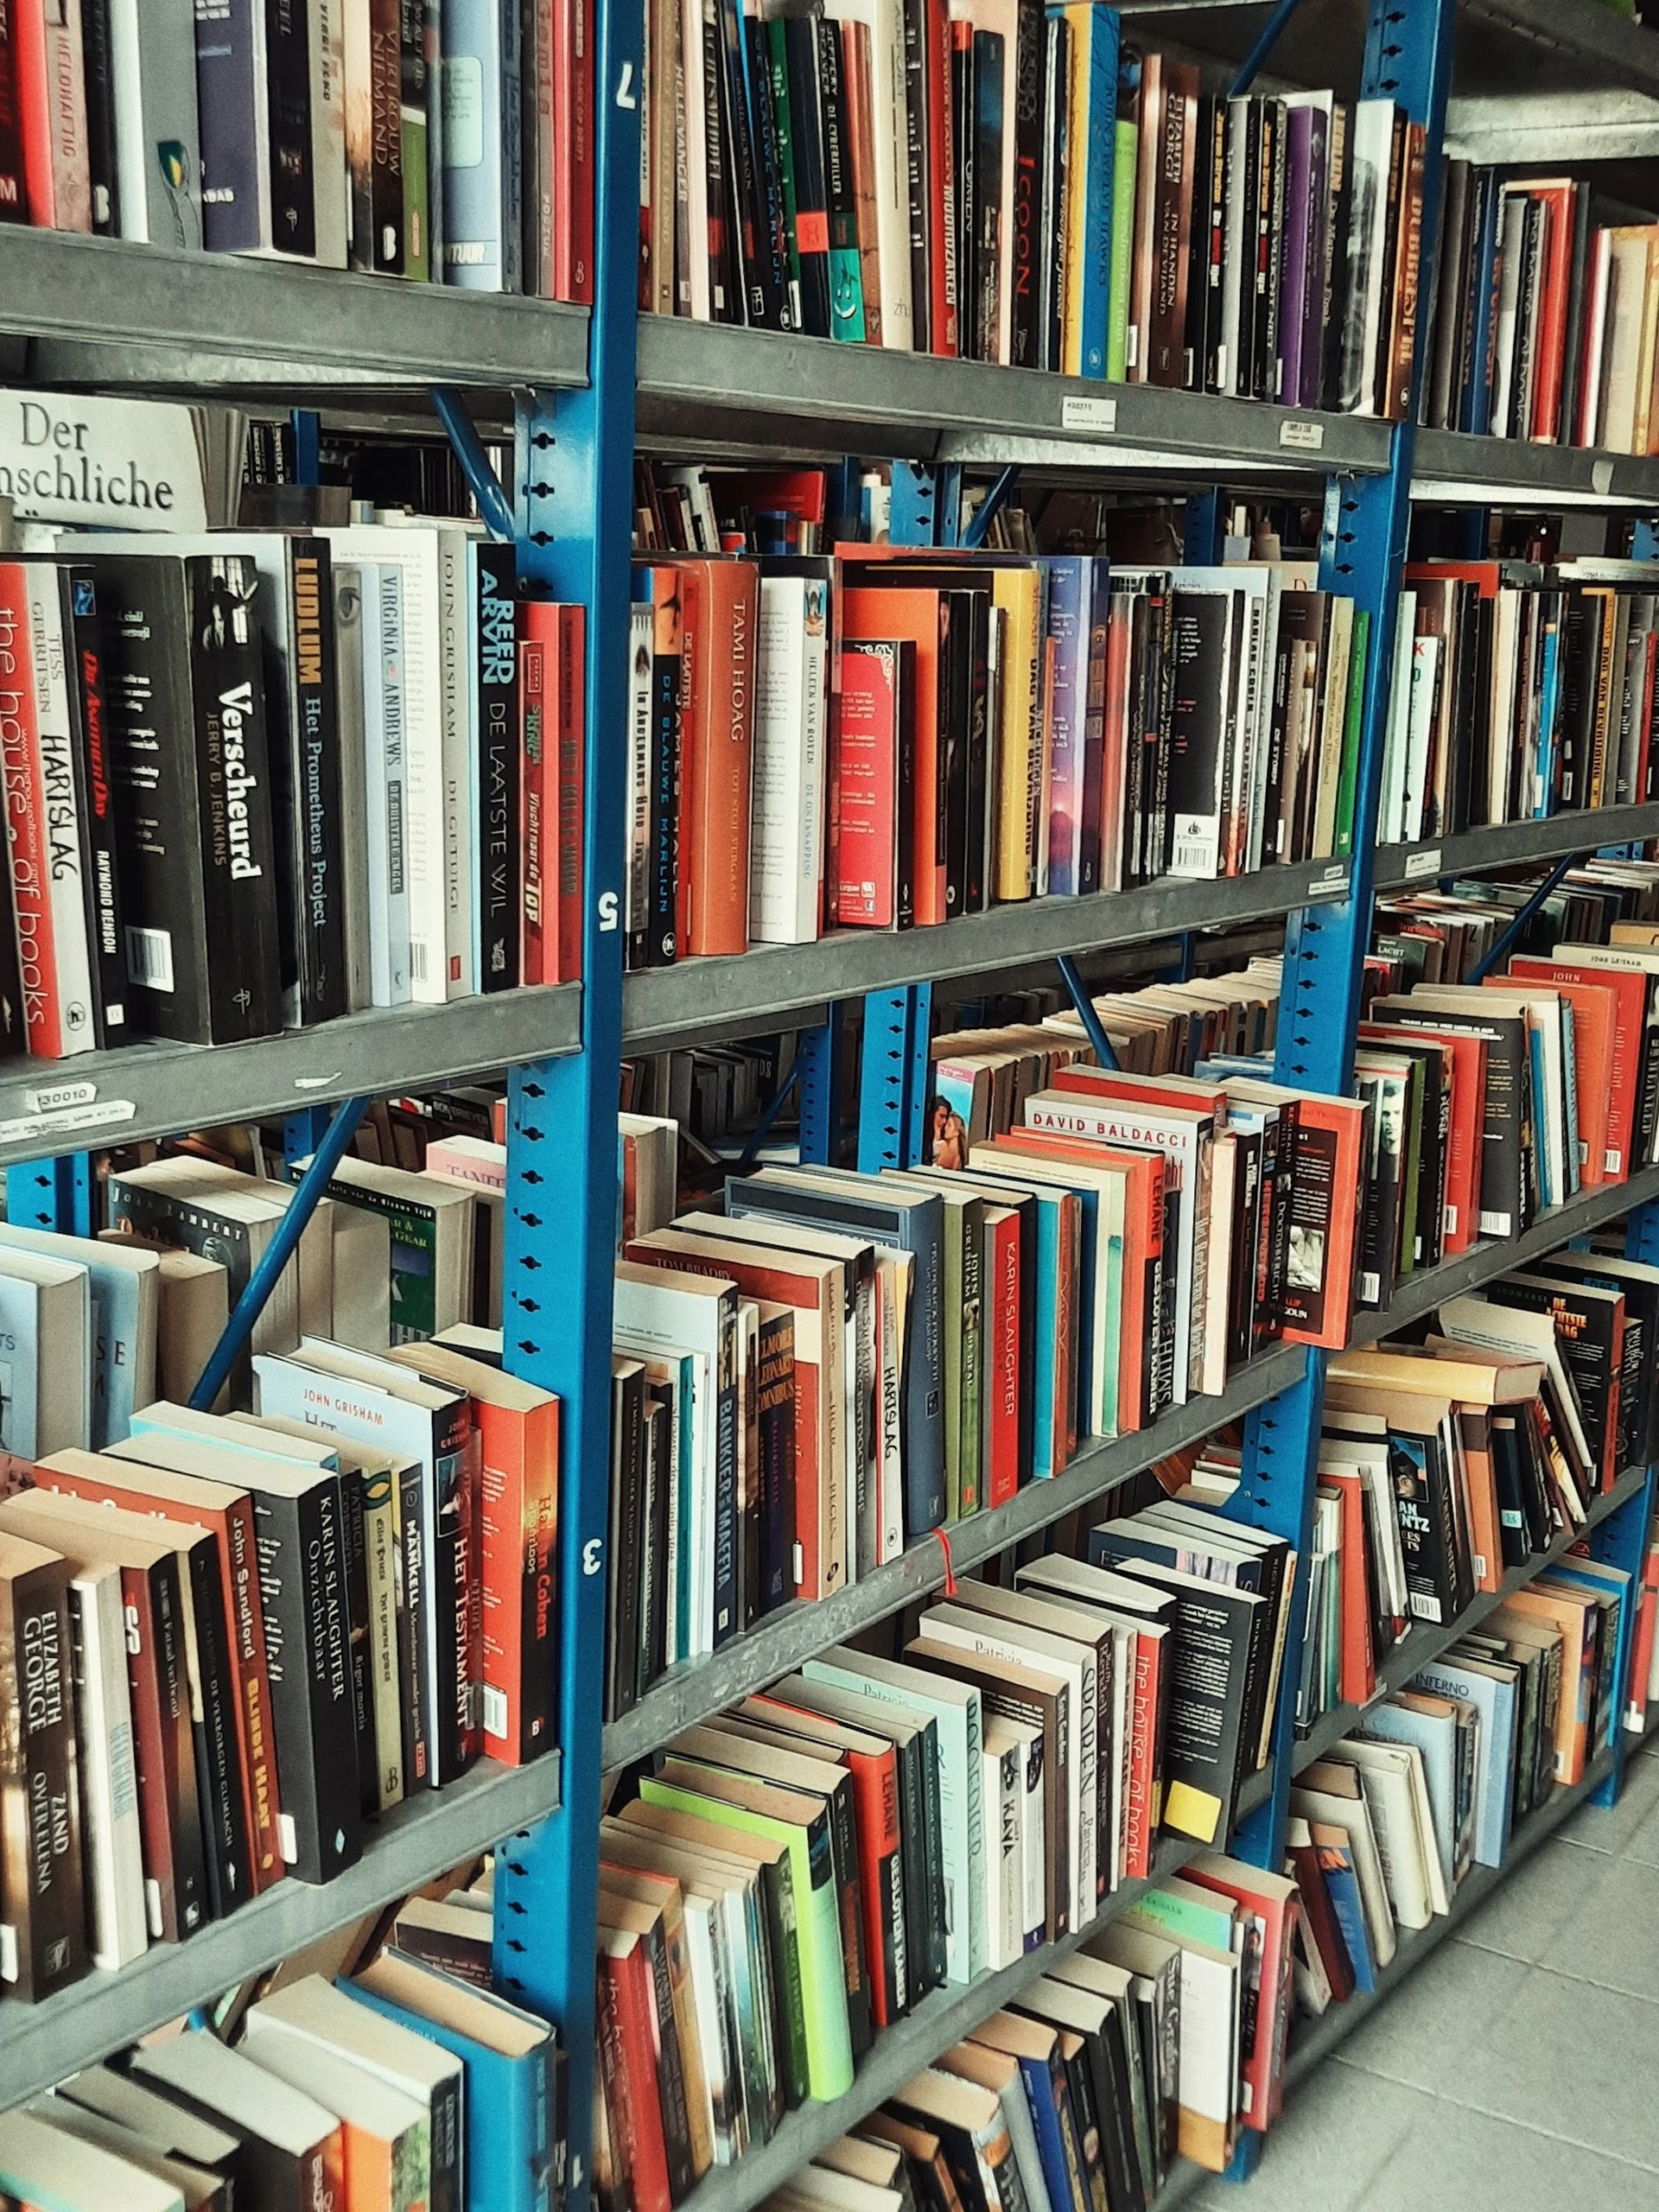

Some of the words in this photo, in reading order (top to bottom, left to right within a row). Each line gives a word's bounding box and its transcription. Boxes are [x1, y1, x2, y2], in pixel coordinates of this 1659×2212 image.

[616, 62, 638, 110] 7
[20, 402, 89, 452] Der
[443, 553, 455, 620] JOHN
[296, 556, 323, 685] LUDLUM
[480, 569, 499, 685] ARVIN
[497, 599, 516, 685] REED
[732, 598, 747, 661] TAMI
[32, 601, 53, 714] GERRITSEN
[50, 633, 62, 682] TESS
[445, 626, 458, 741] GRISHAM
[661, 674, 673, 699] DE
[807, 654, 819, 699] HELEEN
[206, 710, 221, 766] JERRY
[305, 696, 324, 734] Het
[385, 683, 403, 766] ANDREWS
[489, 701, 508, 735] DE
[730, 668, 747, 742] HOAG
[806, 702, 817, 722] VAN
[2, 690, 33, 813] house
[660, 711, 672, 806] BLAUWE
[805, 725, 817, 766] ROYEN
[42, 734, 77, 881] HARTSLAG
[219, 681, 264, 880] Verscheurd
[306, 741, 327, 855] Prometheus
[489, 745, 508, 857] LAATSTE
[211, 792, 230, 867] JENKINS
[13, 857, 40, 897] of
[96, 849, 117, 905] RAYMOND
[307, 860, 329, 927] Project
[489, 863, 508, 918] WIL
[658, 817, 671, 913] MARLIJN
[596, 891, 619, 932] 5
[21, 910, 50, 1025] books
[1033, 1112, 1086, 1131] DAVID
[1096, 1122, 1187, 1148] BALDACCI
[1005, 1241, 1018, 1302] KARIN
[1271, 1200, 1287, 1301] DOODSBERICHT
[1002, 1304, 1017, 1416] SLAUGHTER
[303, 1387, 331, 1407] JOHN
[334, 1397, 385, 1426] GRISHAM
[882, 1365, 898, 1459] HARTSLAG
[230, 1516, 248, 1565] John
[318, 1494, 340, 1568] KARIN
[406, 1519, 420, 1609] MANKELL
[454, 1536, 472, 1586] HET
[581, 1536, 602, 1575] 3
[235, 1569, 257, 1660] Sandford
[307, 1538, 328, 1683] Onzichtbaar
[321, 1570, 346, 1702] SLAUGHTER
[23, 1616, 52, 1734] GEORGE
[41, 1611, 65, 1726] ELIZABETH
[454, 1592, 473, 1730] TESTAMENT
[1135, 1656, 1151, 1689] the
[1415, 1674, 1469, 1697] INFERNO
[1132, 1695, 1150, 1761] house
[52, 1792, 71, 1855] ZAND
[1131, 1779, 1147, 1802] of
